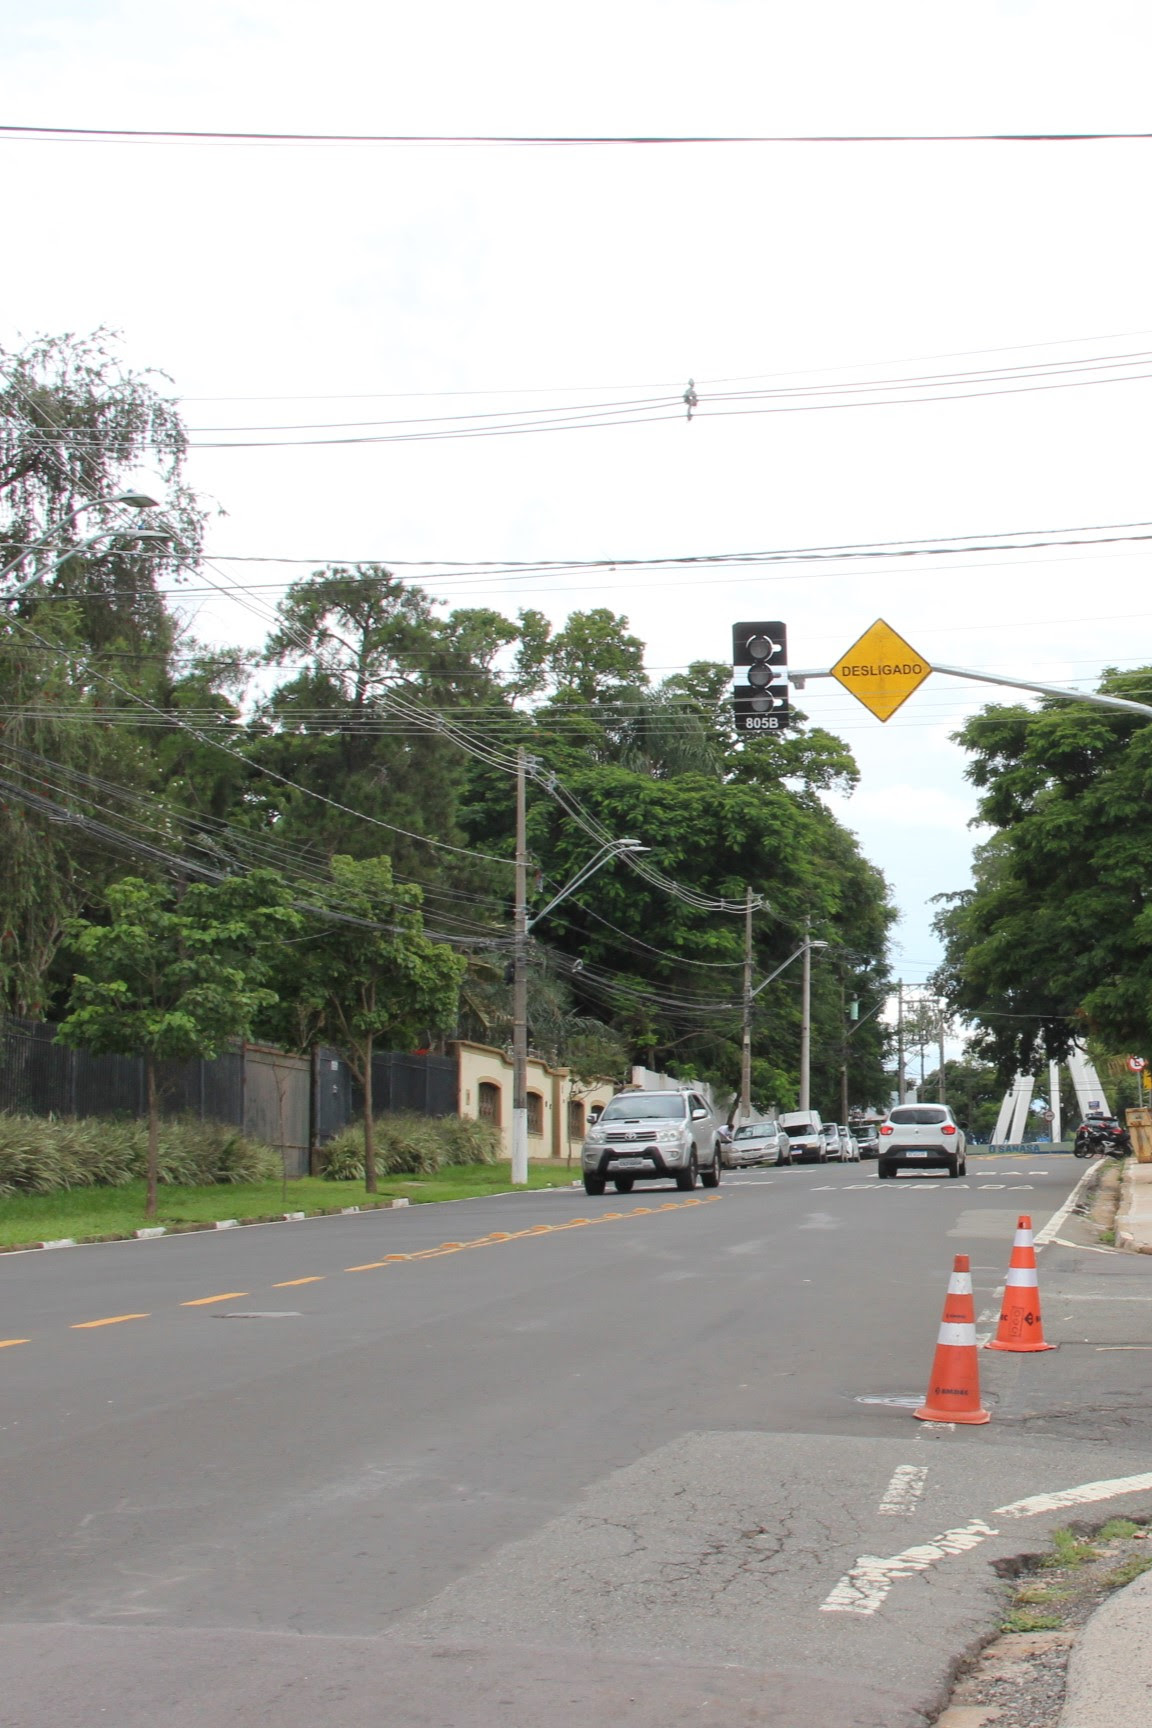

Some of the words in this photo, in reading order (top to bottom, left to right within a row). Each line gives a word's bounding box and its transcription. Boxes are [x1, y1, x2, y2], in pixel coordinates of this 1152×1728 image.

[842, 664, 922, 677] DESLIGADO
[745, 717, 779, 729] 805B
[998, 1144, 1040, 1153] SANASA
